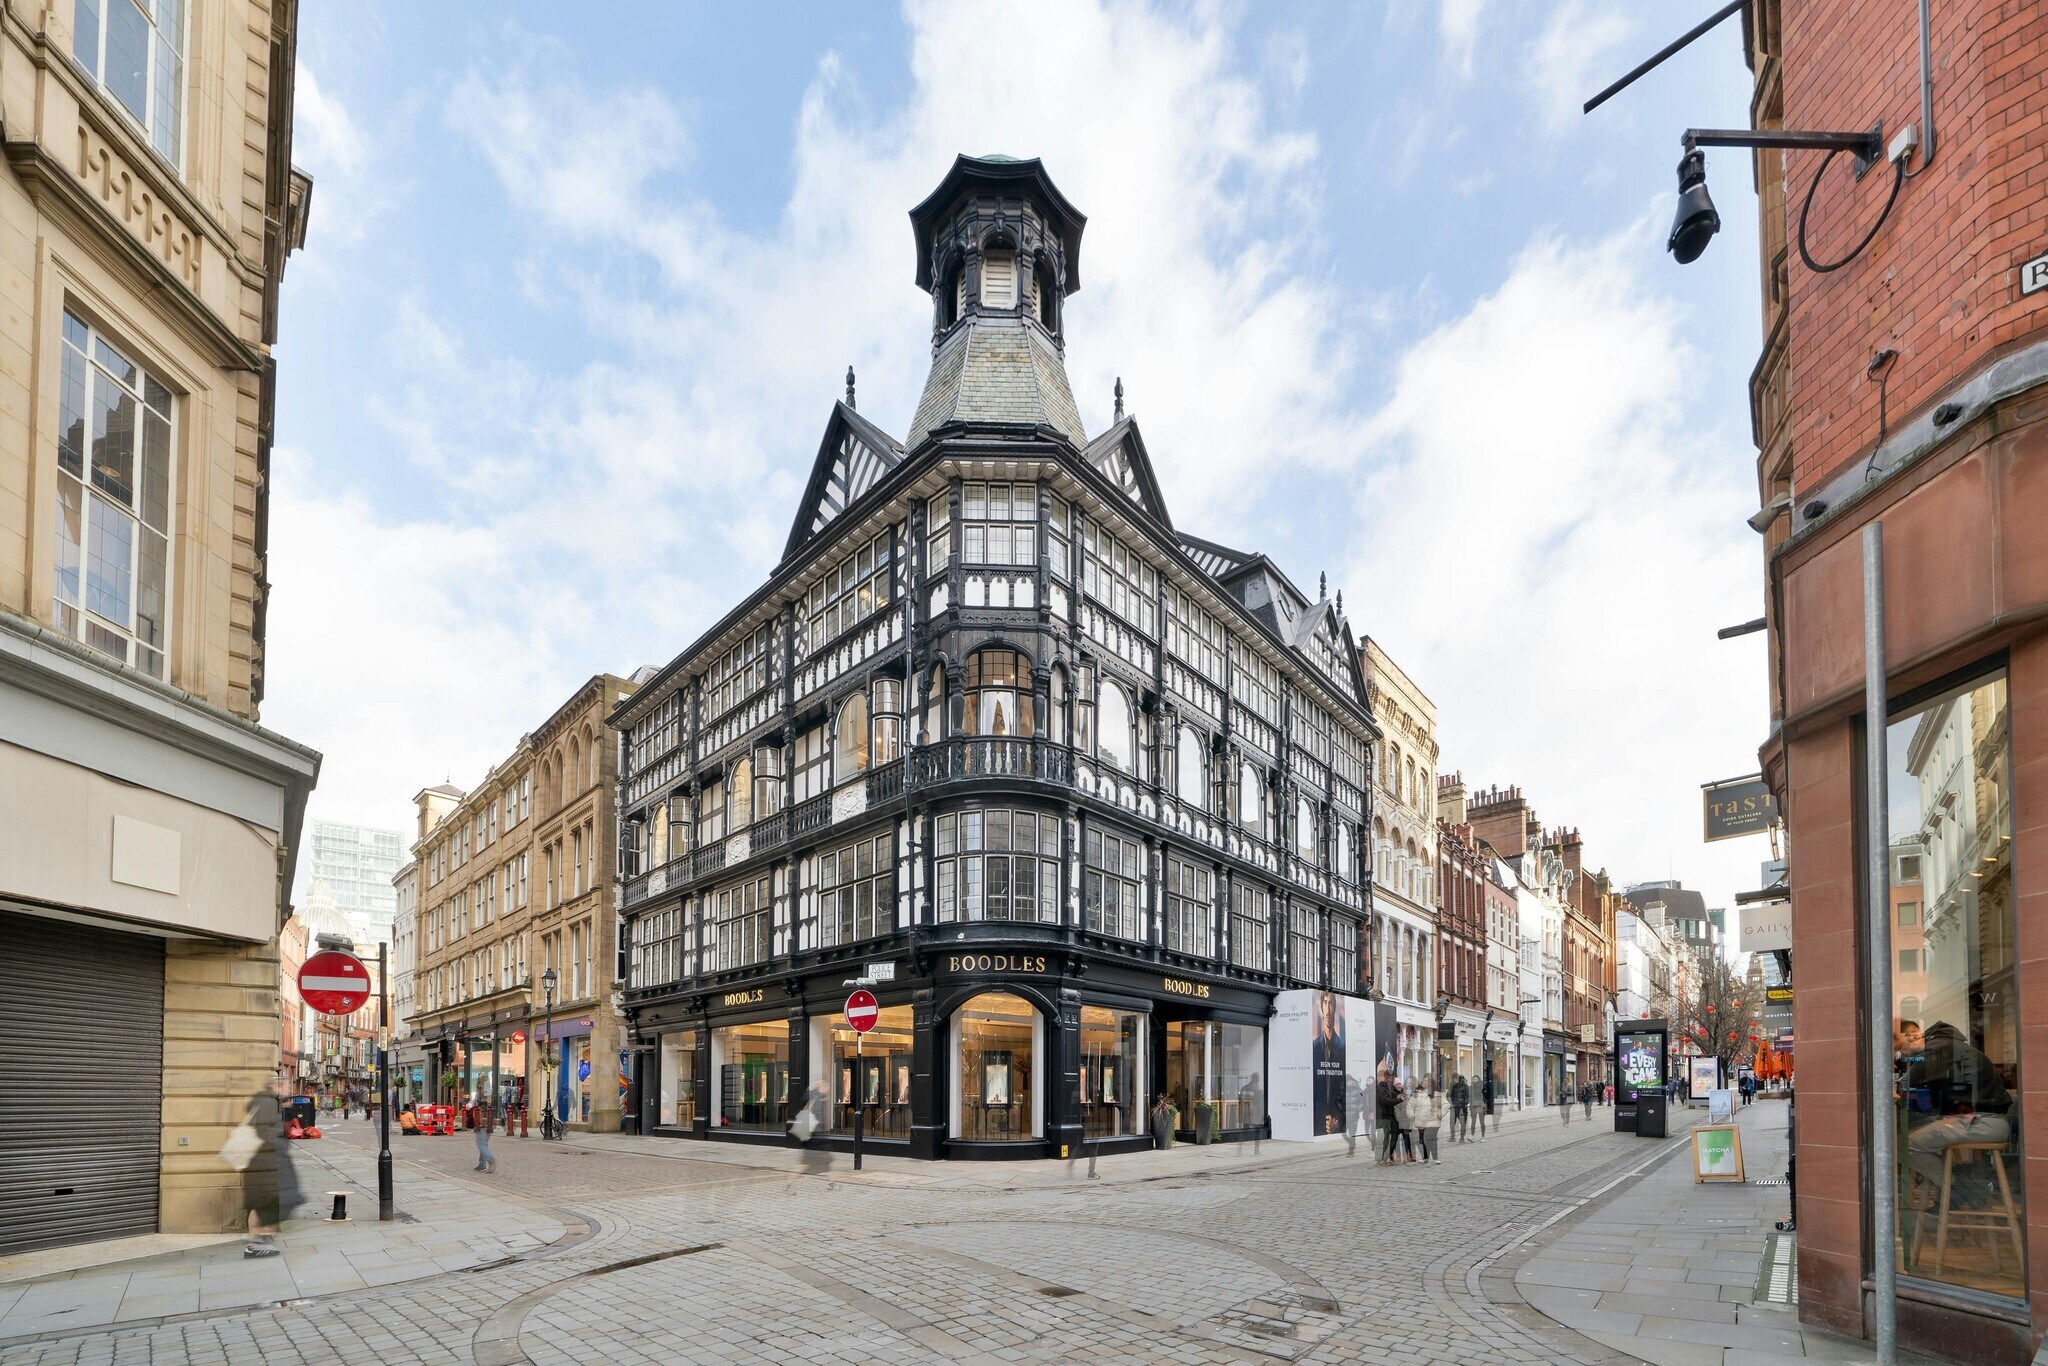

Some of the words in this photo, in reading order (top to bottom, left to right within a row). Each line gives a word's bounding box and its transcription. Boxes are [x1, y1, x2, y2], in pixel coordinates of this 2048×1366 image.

[950, 955, 1045, 972] BOODLES
[871, 971, 893, 979] STREET
[1164, 978, 1209, 998] BOODLES
[725, 989, 762, 1006] BOODLES
[1629, 1052, 1656, 1067] EVERY
[1631, 1067, 1657, 1085] GAME
